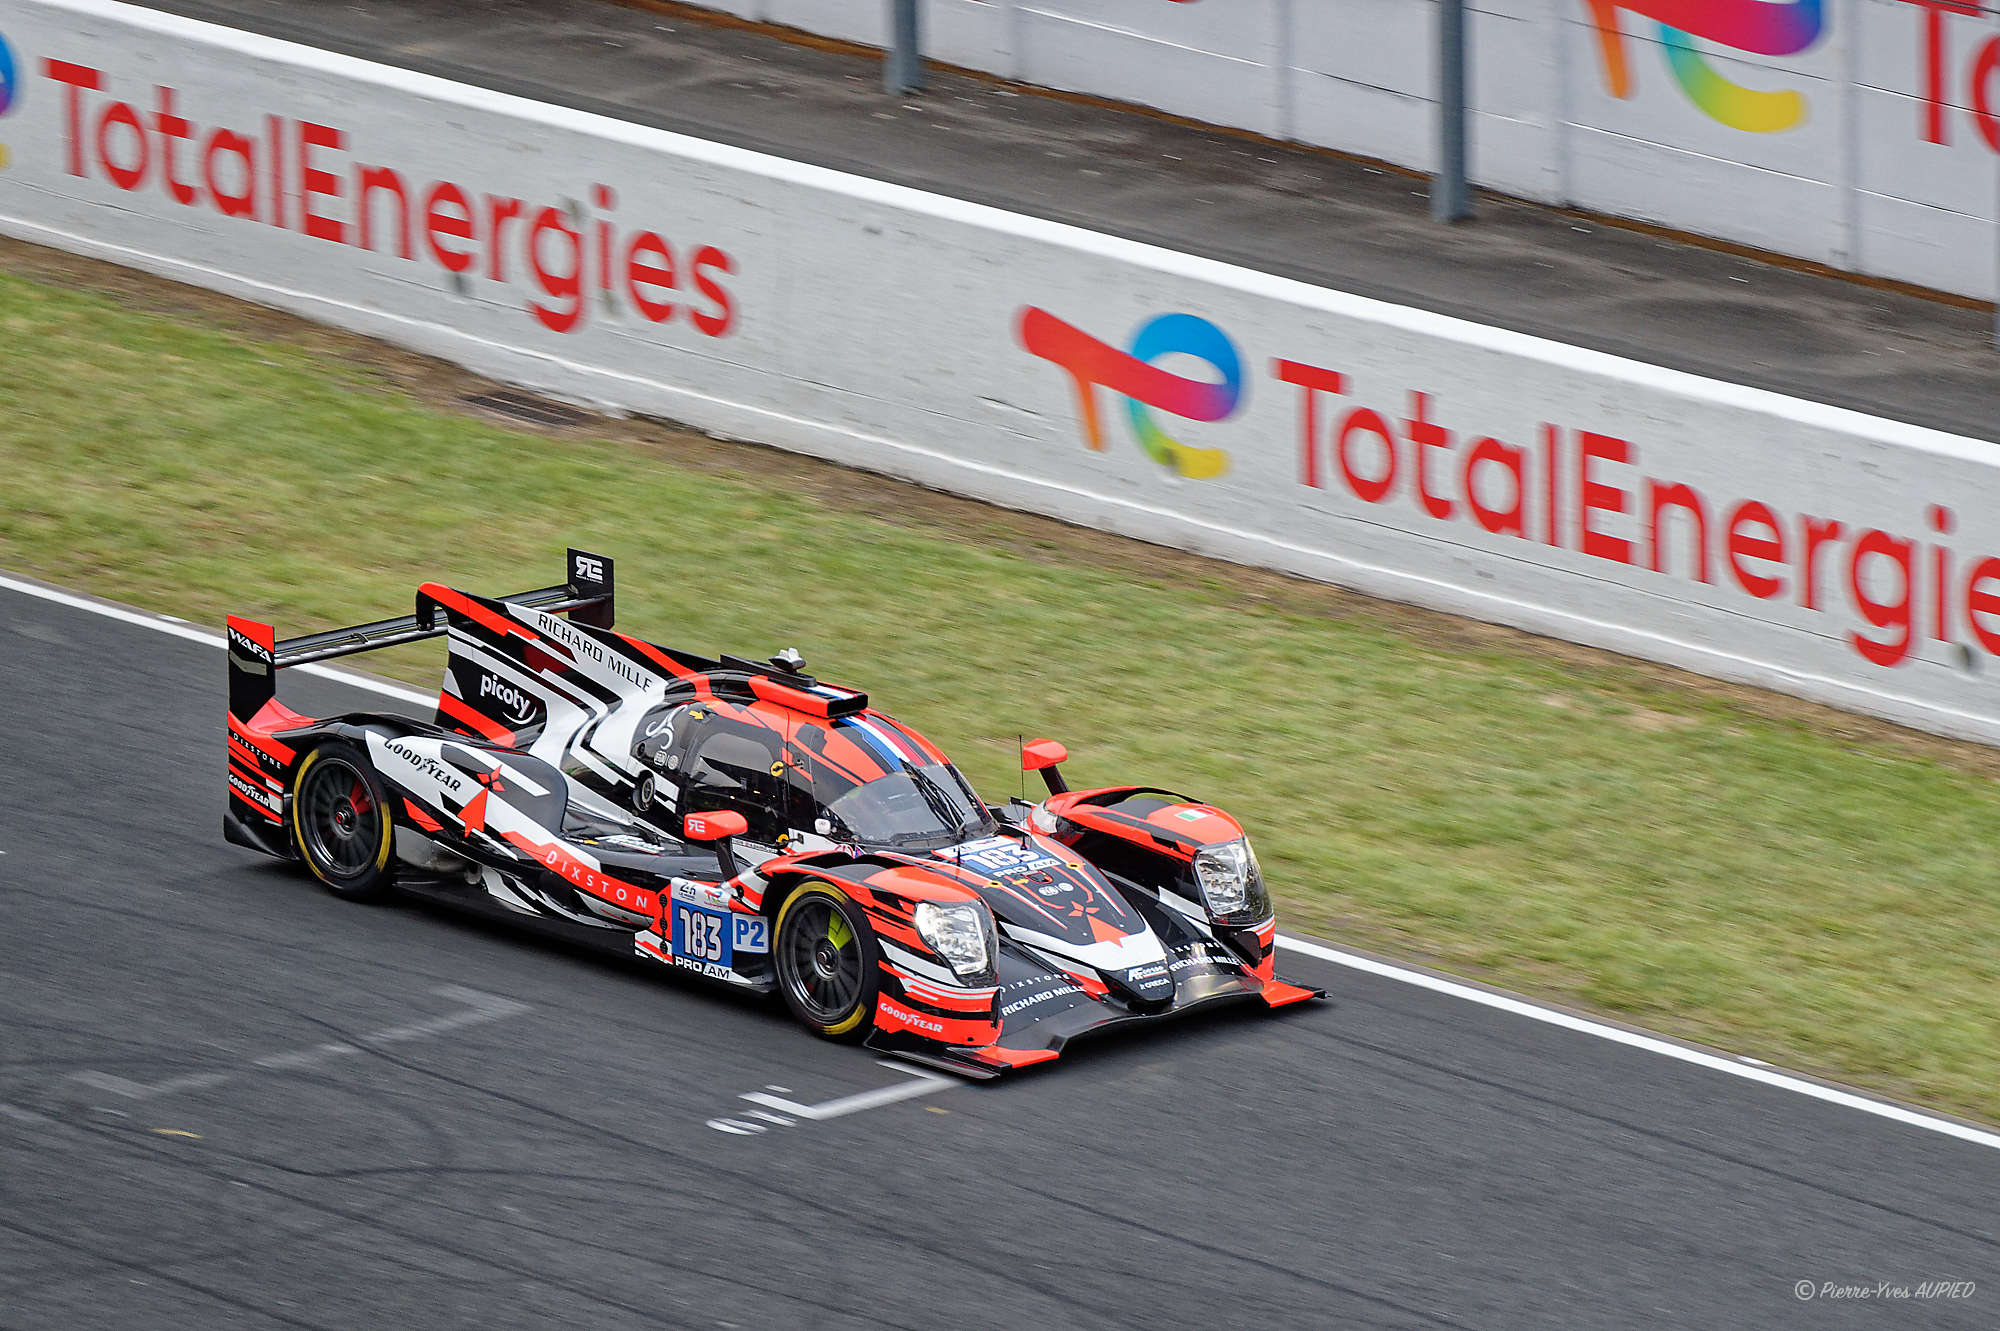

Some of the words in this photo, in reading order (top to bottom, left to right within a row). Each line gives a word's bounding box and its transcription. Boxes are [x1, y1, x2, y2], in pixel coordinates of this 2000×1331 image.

[38, 55, 740, 338] TotalEnergies
[228, 627, 272, 663] WAFA
[538, 613, 603, 663] RICHARD
[607, 655, 653, 693] MILLE
[480, 674, 531, 719] picoty
[233, 733, 281, 769] DIXSTONE
[384, 740, 461, 792] GOODYEAR
[229, 774, 271, 807] GOODYEAR
[960, 844, 1040, 869] 183
[679, 906, 722, 961] 183
[736, 918, 765, 947] P2
[675, 956, 703, 972] PRO
[1169, 956, 1214, 971] RICHARD
[880, 1002, 944, 1033] GOODYEAR
[1001, 990, 1055, 1017] RICHARD
